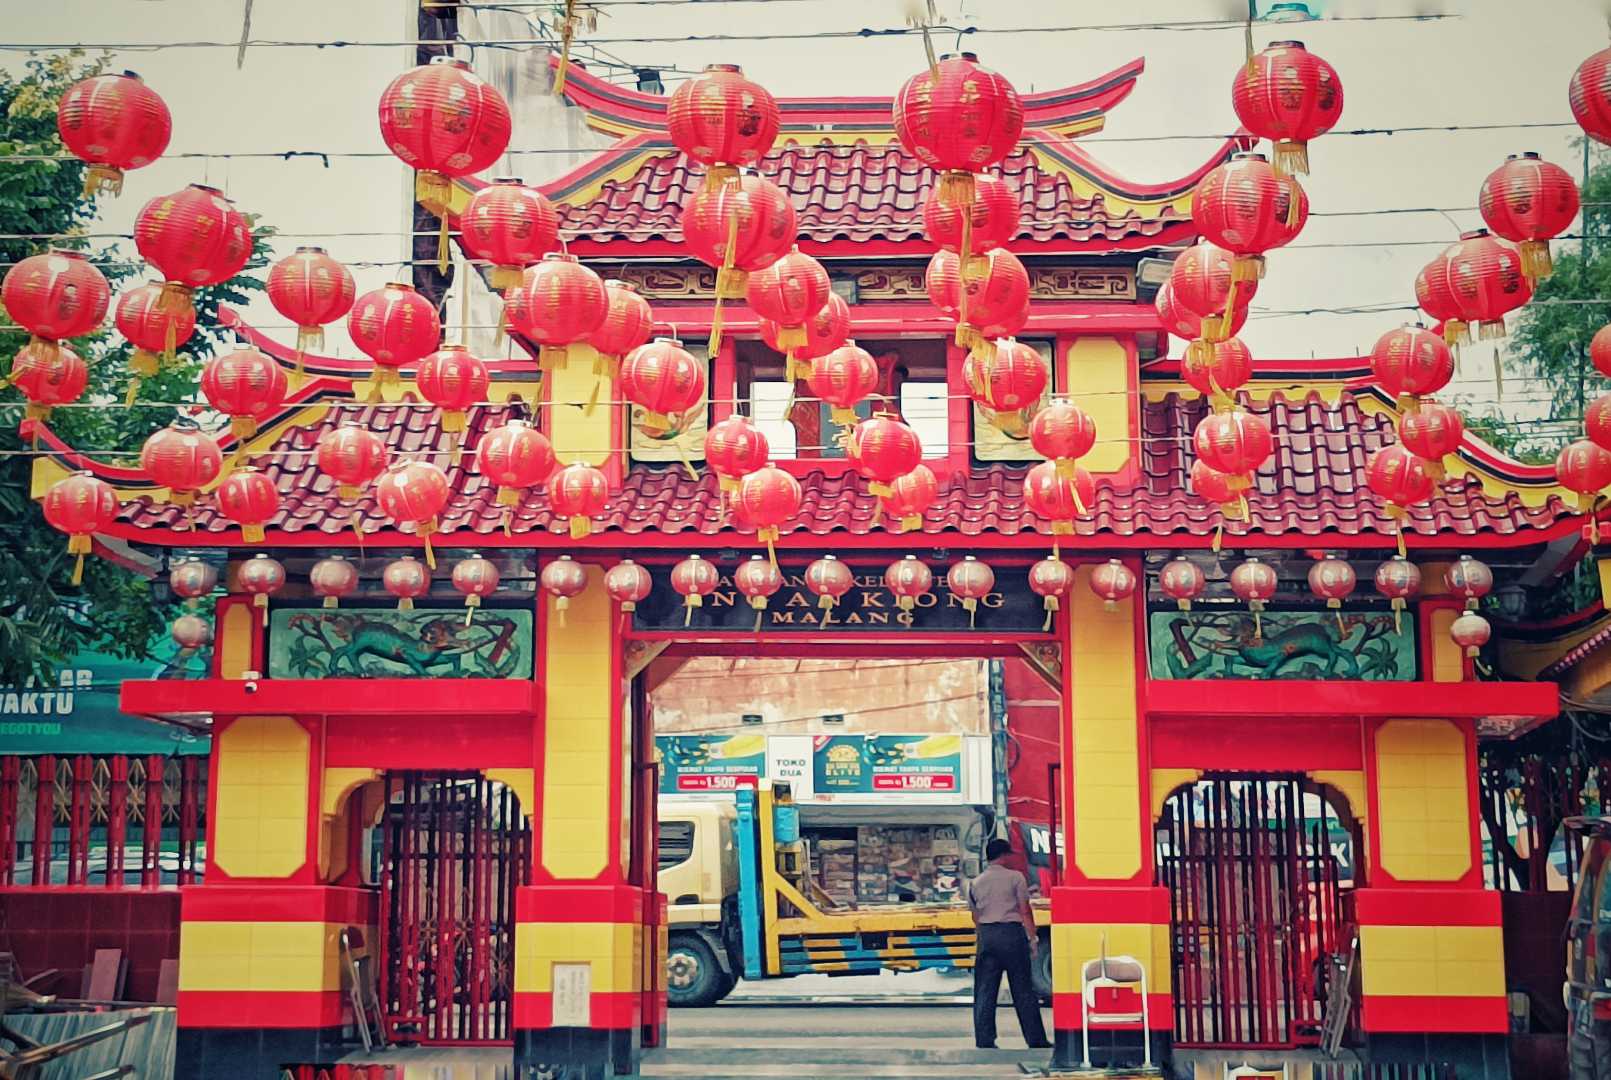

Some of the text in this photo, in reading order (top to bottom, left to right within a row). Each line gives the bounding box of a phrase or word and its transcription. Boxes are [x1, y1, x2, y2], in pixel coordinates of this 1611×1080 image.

[772, 611, 914, 625] MALANG
[776, 759, 806, 767] TOKO
[780, 769, 802, 777] DUA
